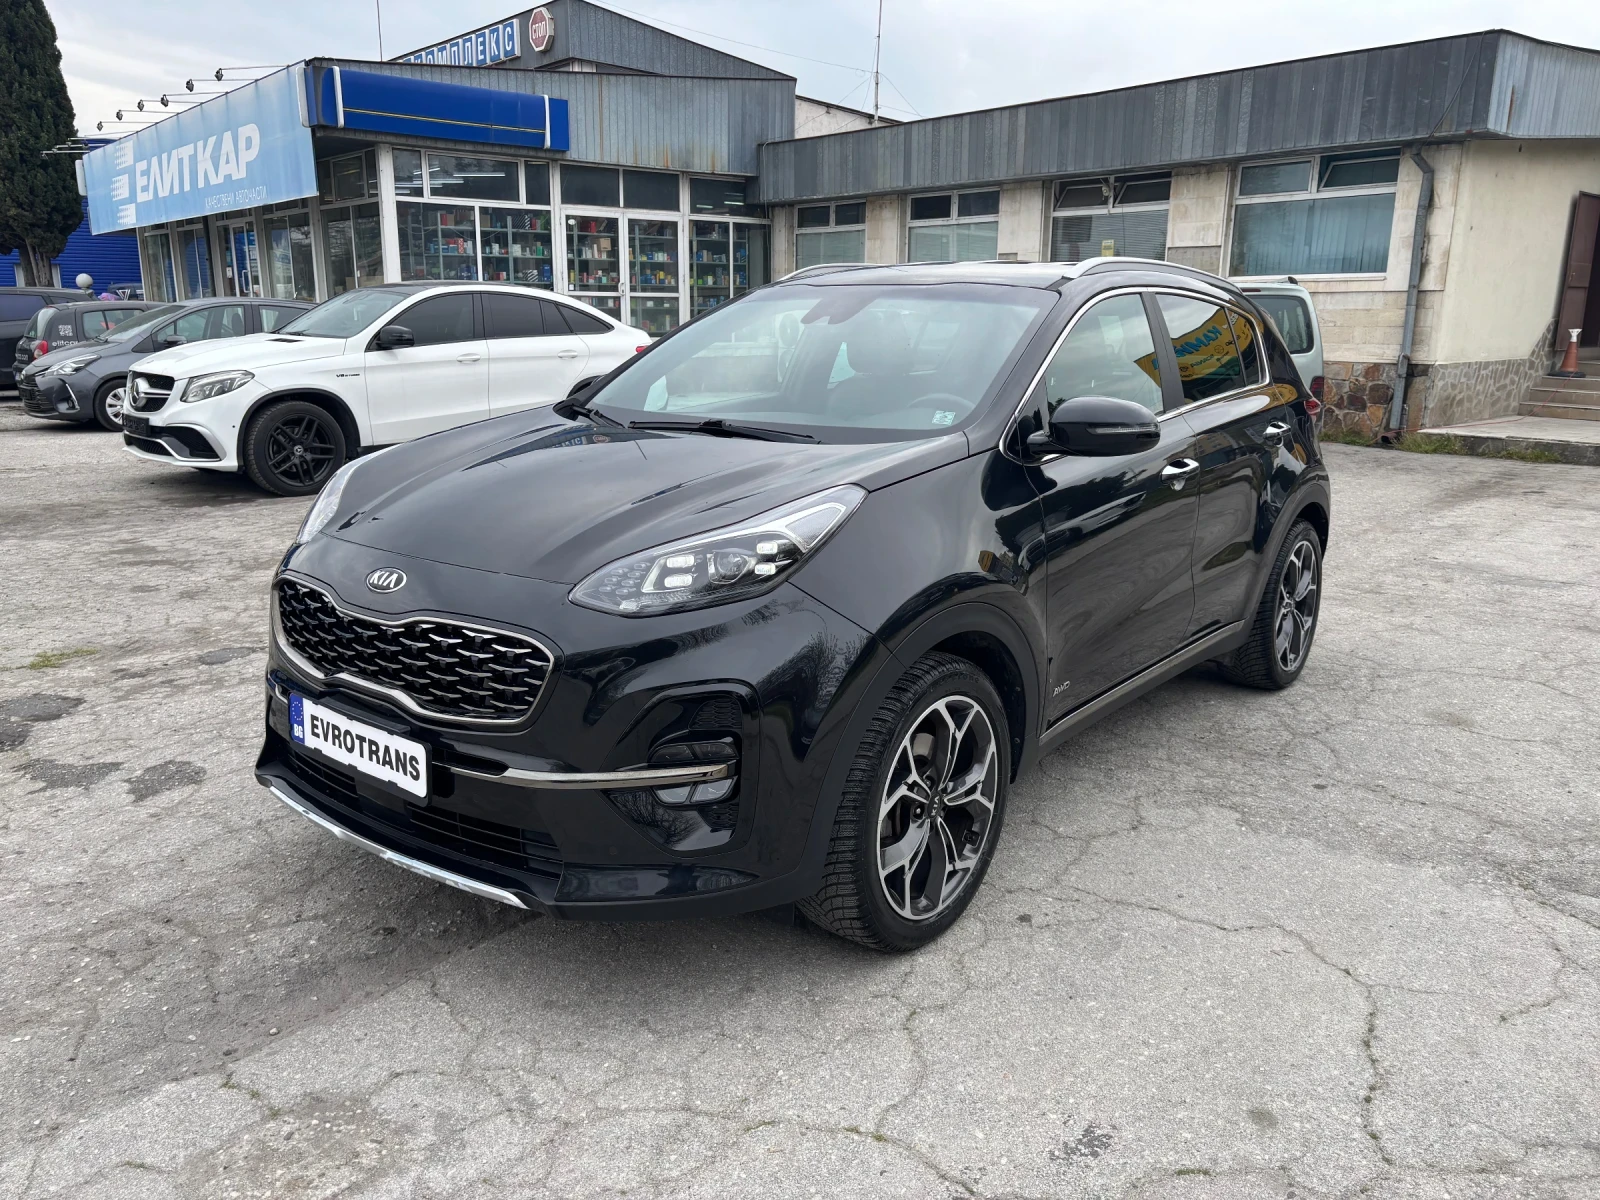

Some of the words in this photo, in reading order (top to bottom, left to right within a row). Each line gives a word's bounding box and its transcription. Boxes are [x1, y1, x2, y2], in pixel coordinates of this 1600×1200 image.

[532, 21, 546, 40] СТОП
[369, 570, 399, 589] KIA
[1052, 680, 1071, 698] AWD
[293, 723, 304, 739] BG
[310, 713, 421, 782] EVROTRANS
